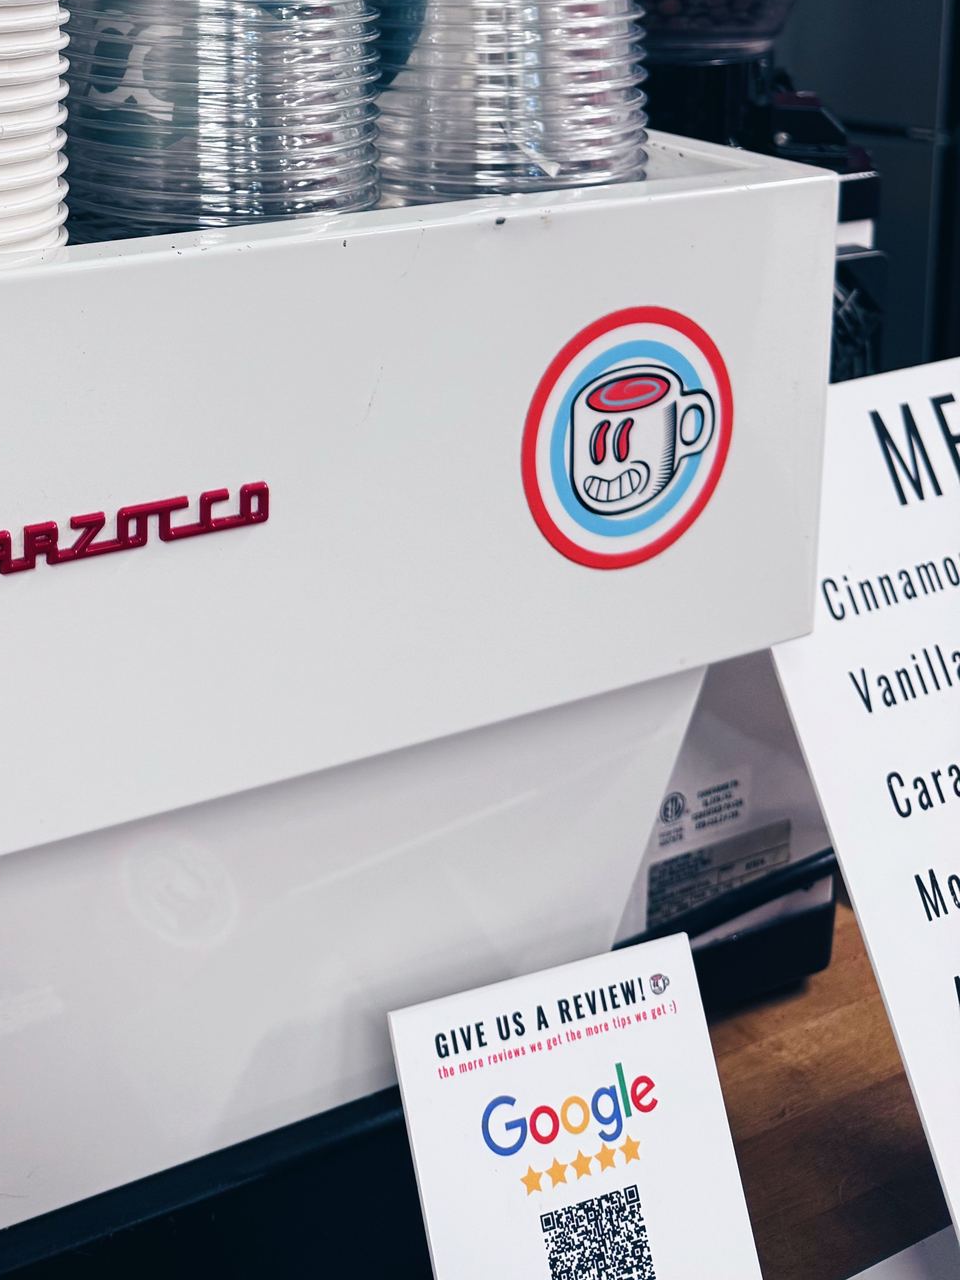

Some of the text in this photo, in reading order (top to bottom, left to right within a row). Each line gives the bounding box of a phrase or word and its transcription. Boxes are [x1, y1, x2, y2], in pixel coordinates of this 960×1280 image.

[821, 552, 960, 621] Cinnamo
[434, 976, 646, 1059] GIVE US A REVIEW!
[437, 1065, 455, 1080] the
[459, 1058, 484, 1074] more
[487, 1048, 526, 1066] reviews
[529, 1041, 543, 1053] we
[546, 1033, 562, 1051] get
[566, 1029, 582, 1043] the
[585, 1021, 609, 1037] more
[612, 1014, 632, 1029] tips
[634, 1010, 647, 1023] we
[651, 1003, 666, 1020] get
[481, 1062, 658, 1157] Google
